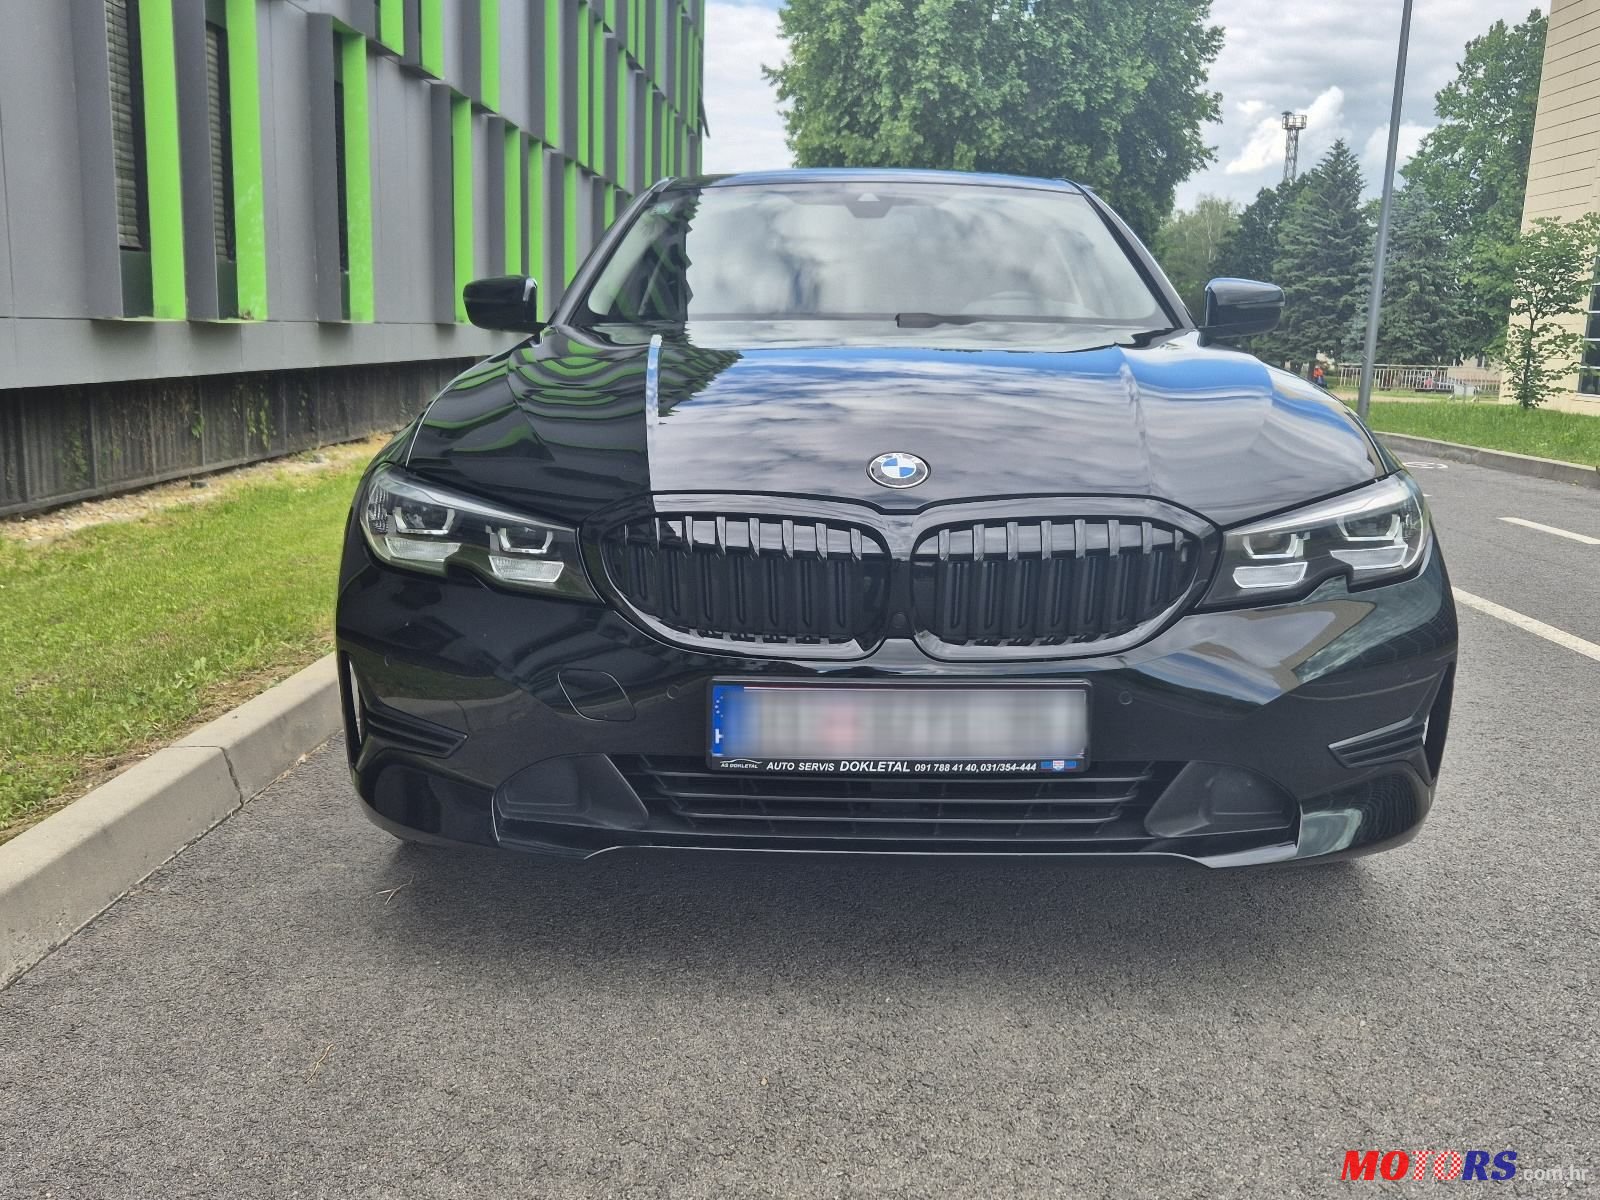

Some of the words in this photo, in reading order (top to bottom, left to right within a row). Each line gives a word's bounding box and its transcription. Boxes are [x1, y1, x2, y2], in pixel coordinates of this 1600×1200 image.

[766, 761, 795, 771] AUTO
[798, 762, 835, 771] SERVIS
[839, 760, 911, 772] DOKLETAL
[914, 763, 931, 772] 091
[933, 763, 950, 772] 788
[952, 763, 963, 772] 41
